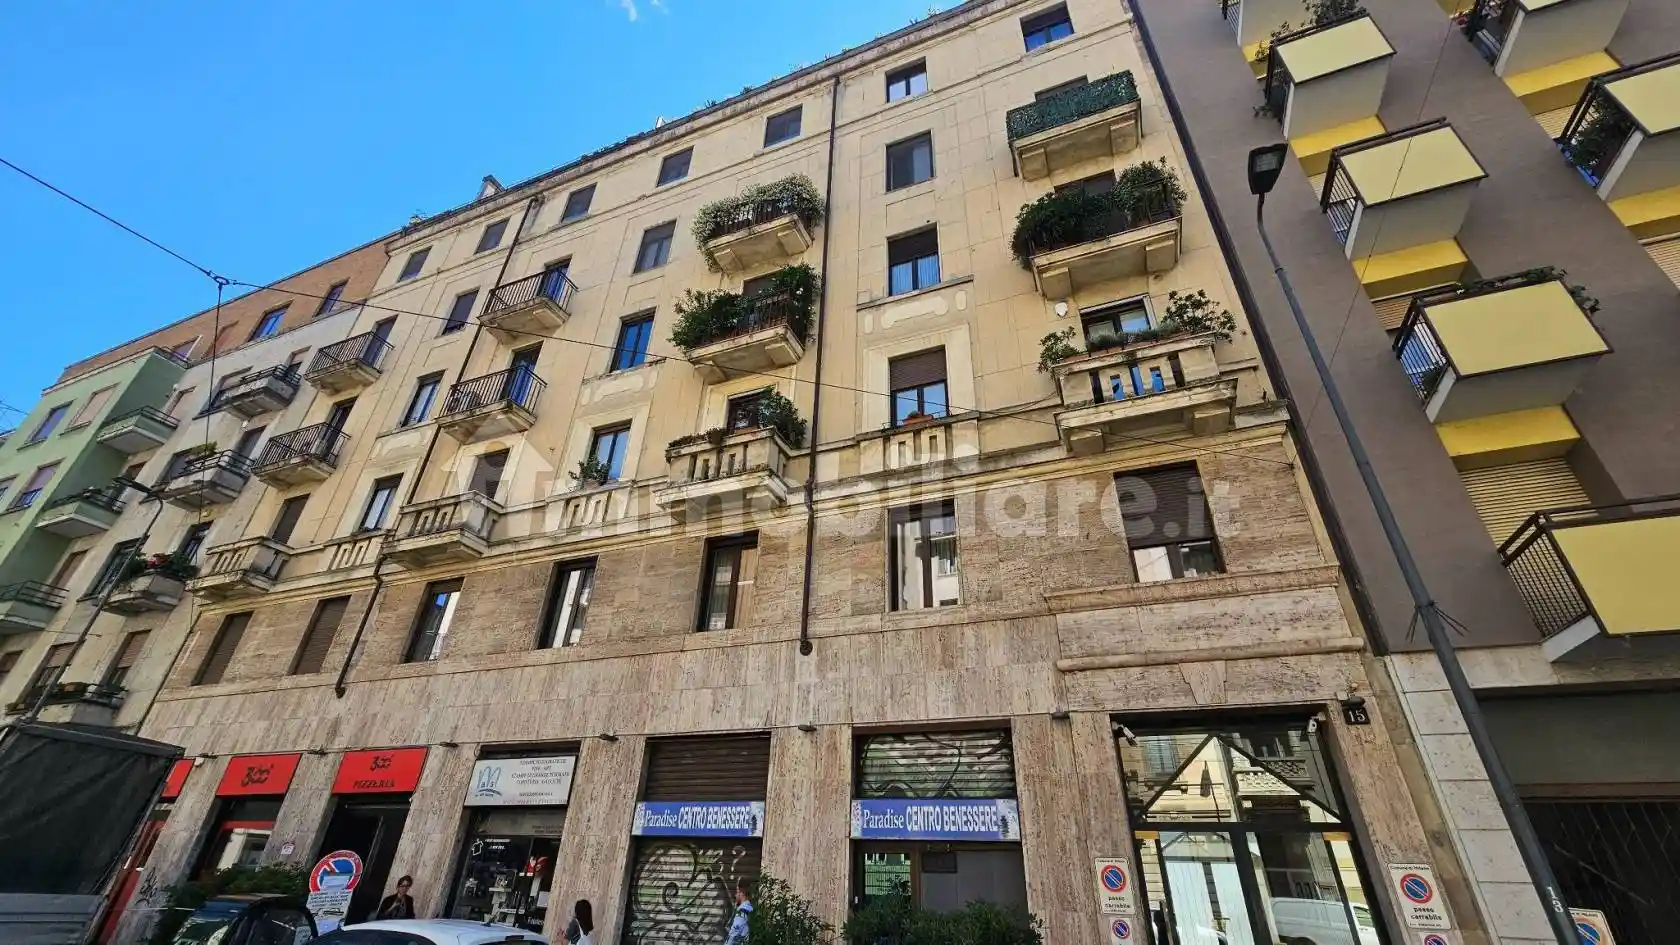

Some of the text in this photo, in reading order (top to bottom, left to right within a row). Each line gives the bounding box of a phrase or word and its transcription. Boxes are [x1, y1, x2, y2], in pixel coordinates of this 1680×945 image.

[1349, 710, 1365, 722] 15
[644, 806, 750, 829] Paradise CENTRO BENESSERE
[863, 805, 998, 832] Paradise CENTRO BENESSERE
